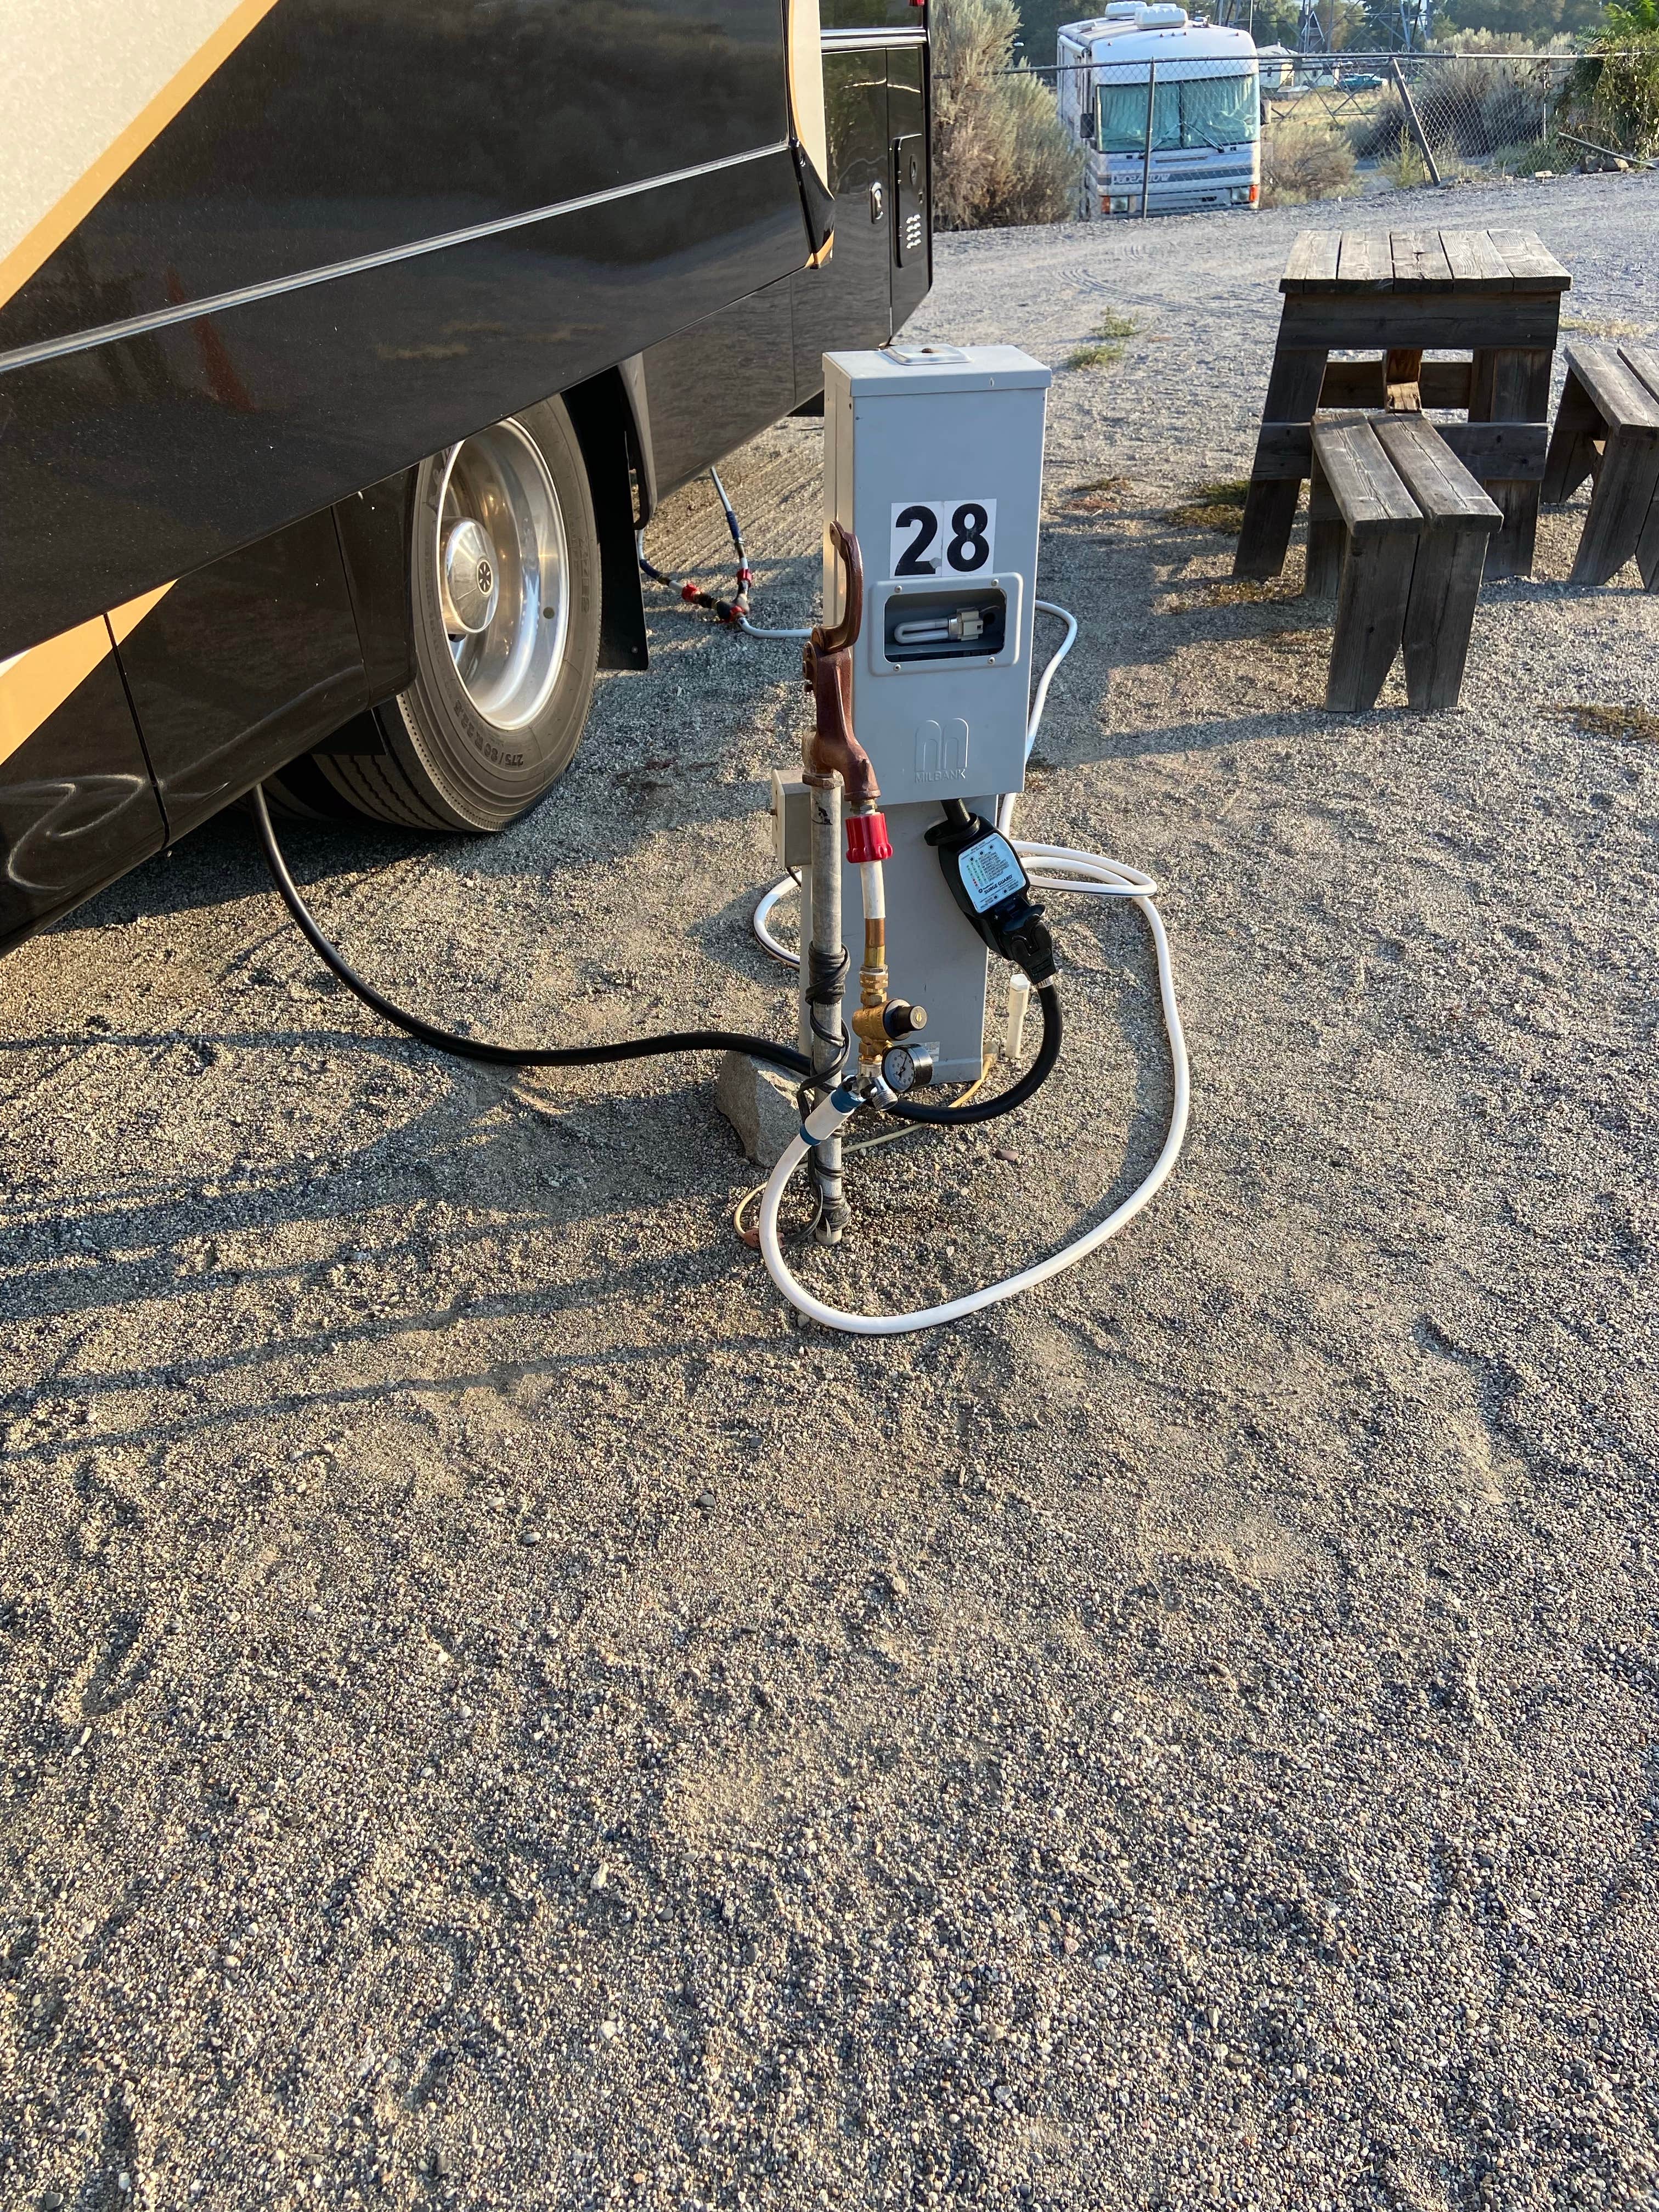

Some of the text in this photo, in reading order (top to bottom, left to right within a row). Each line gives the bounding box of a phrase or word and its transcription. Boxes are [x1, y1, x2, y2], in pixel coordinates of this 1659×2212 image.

[894, 503, 990, 577] 28
[475, 731, 484, 751] R
[484, 743, 524, 767] 275/80
[915, 768, 966, 783] MILBANK
[984, 883, 998, 894] SURGE
[997, 874, 1013, 885] GUARD
